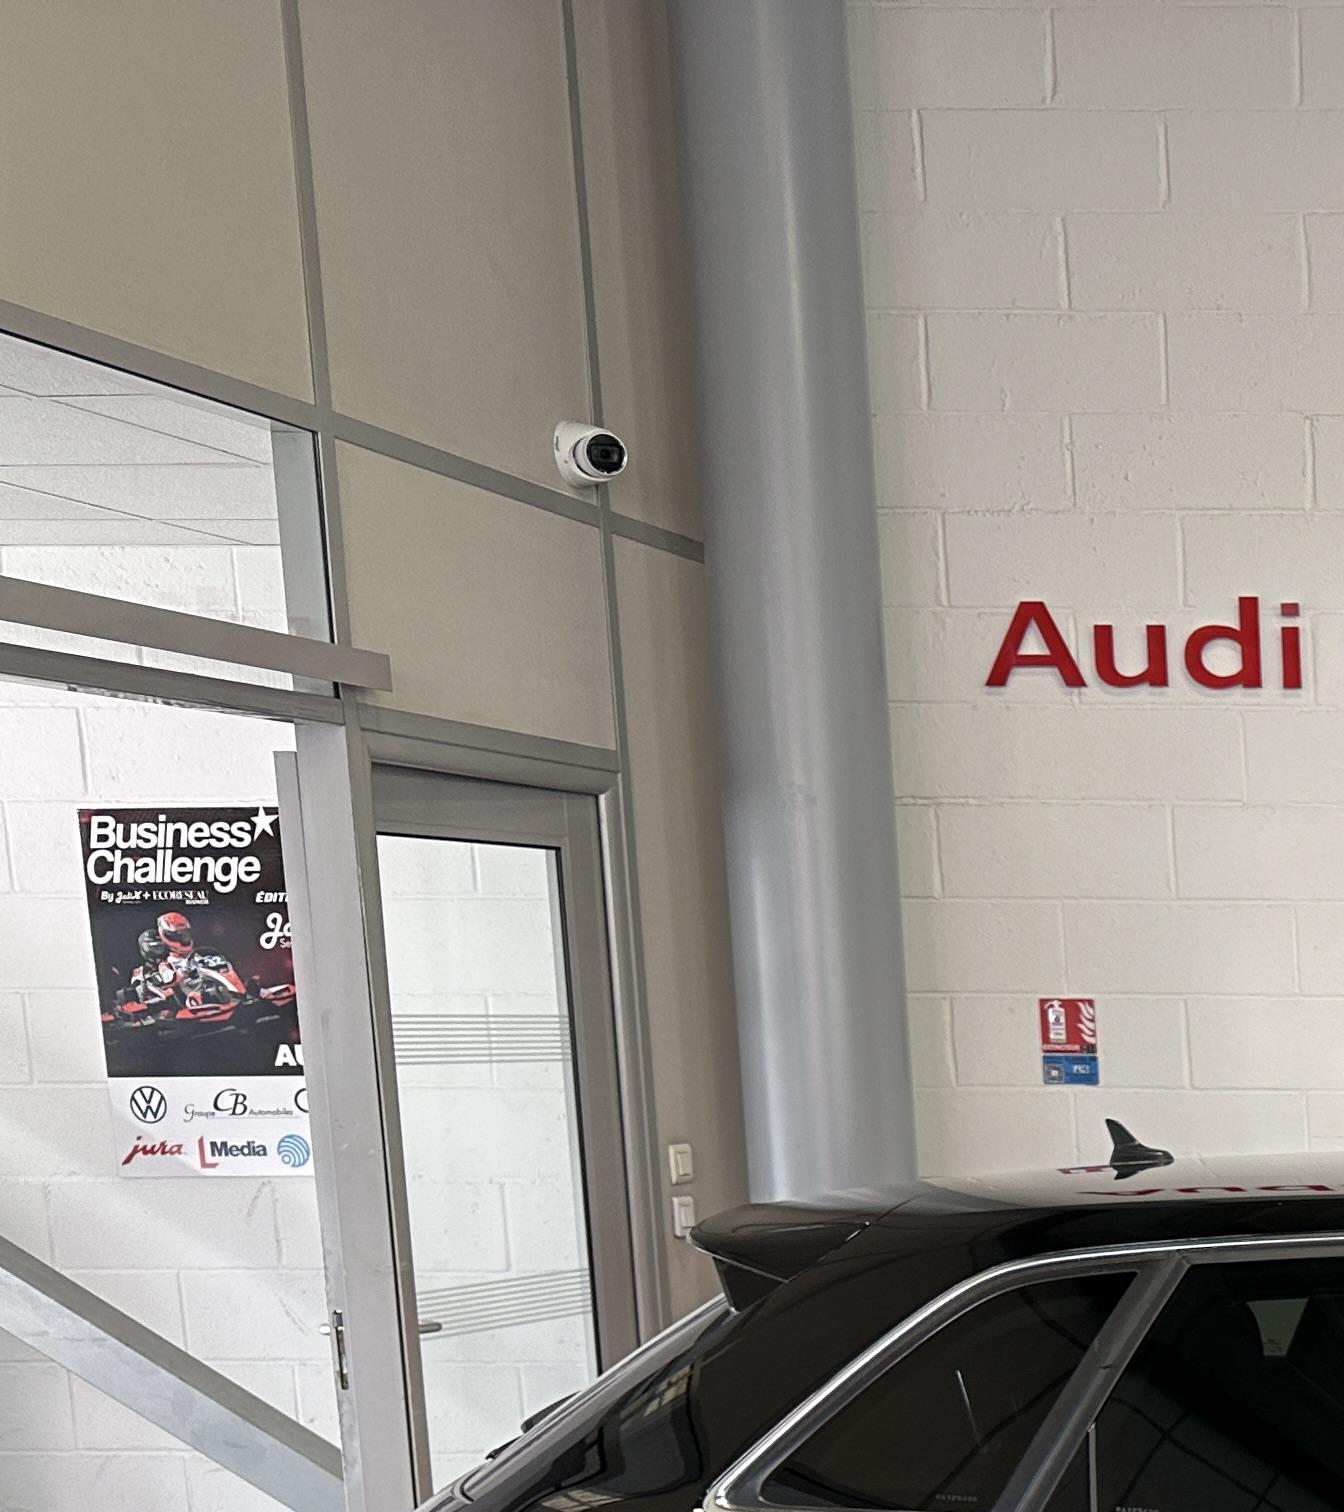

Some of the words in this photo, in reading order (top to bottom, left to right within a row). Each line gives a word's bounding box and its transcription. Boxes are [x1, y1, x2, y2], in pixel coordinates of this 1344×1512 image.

[986, 597, 1302, 689] Audi
[90, 815, 251, 849] Business
[87, 849, 261, 893] Challenge
[213, 1088, 248, 1116] CB
